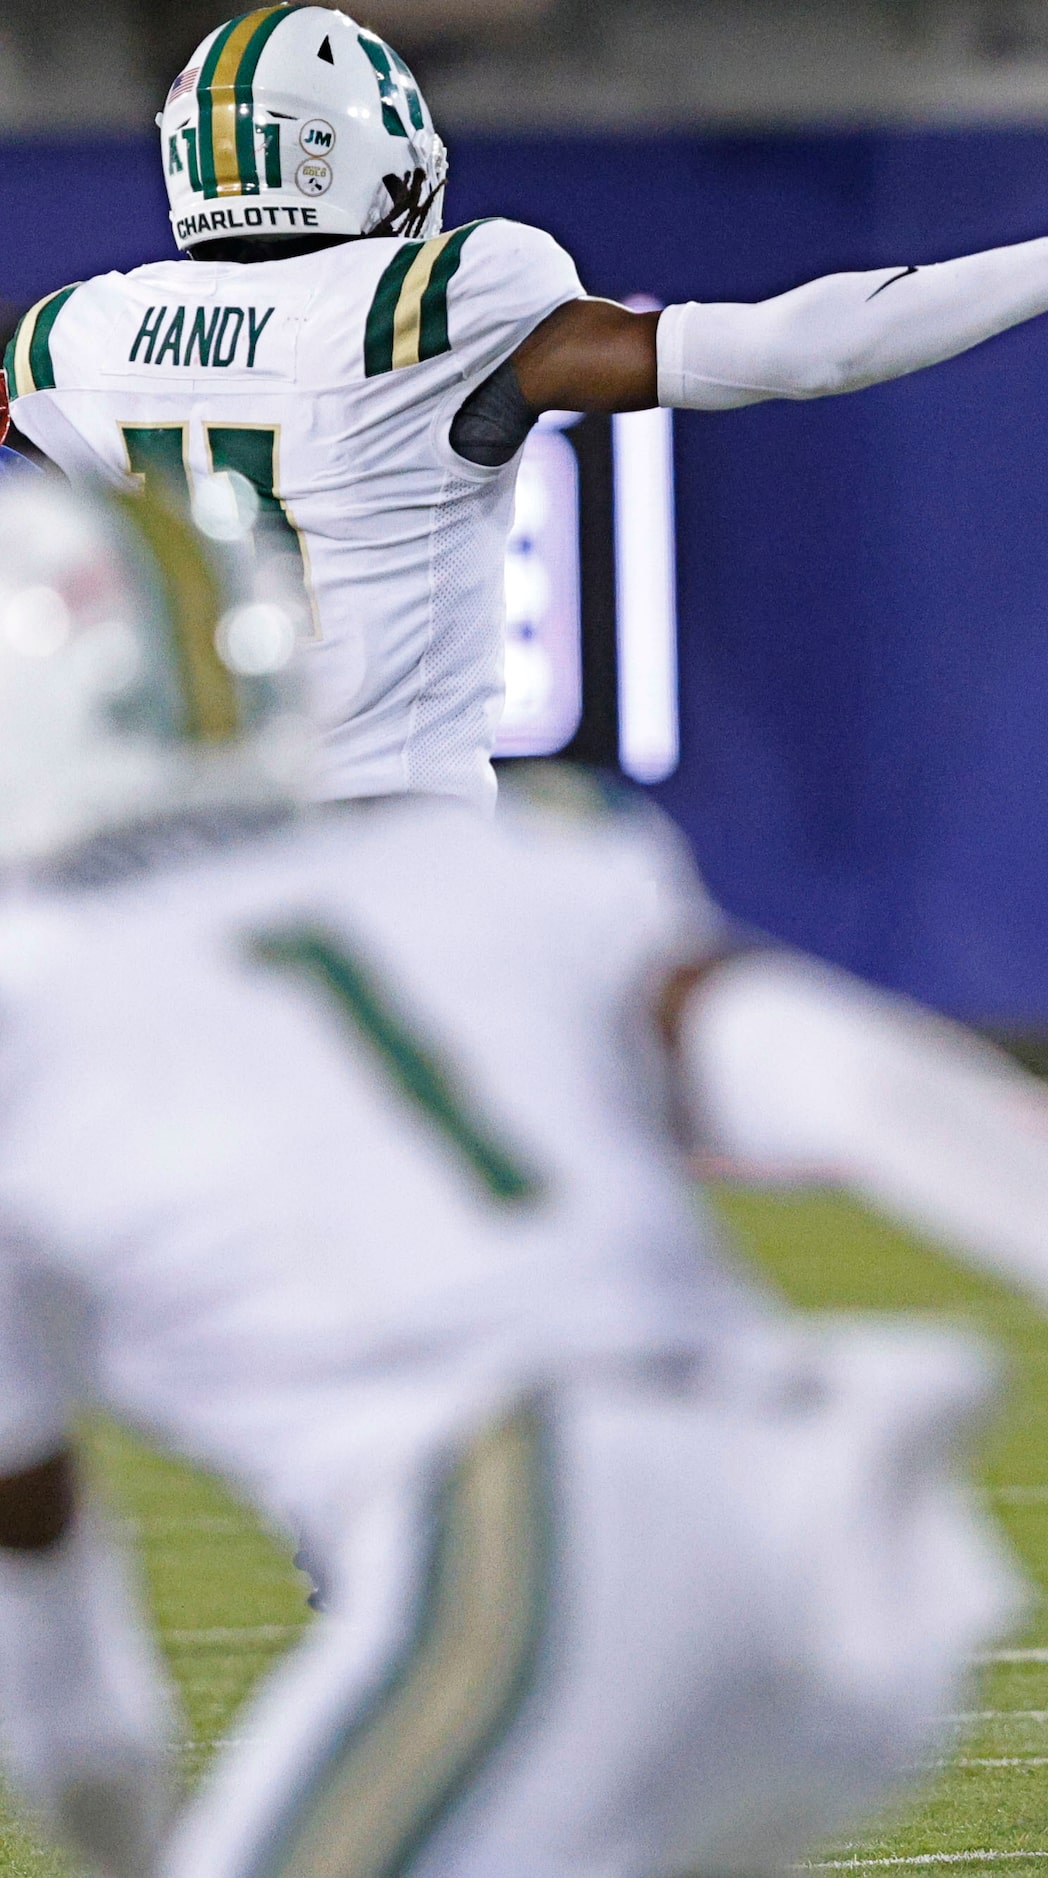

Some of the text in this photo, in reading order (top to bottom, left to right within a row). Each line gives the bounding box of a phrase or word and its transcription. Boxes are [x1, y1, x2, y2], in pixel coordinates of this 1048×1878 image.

[304, 129, 332, 147] JM
[176, 206, 319, 239] CHARLOTTE
[128, 305, 276, 368] HANDY
